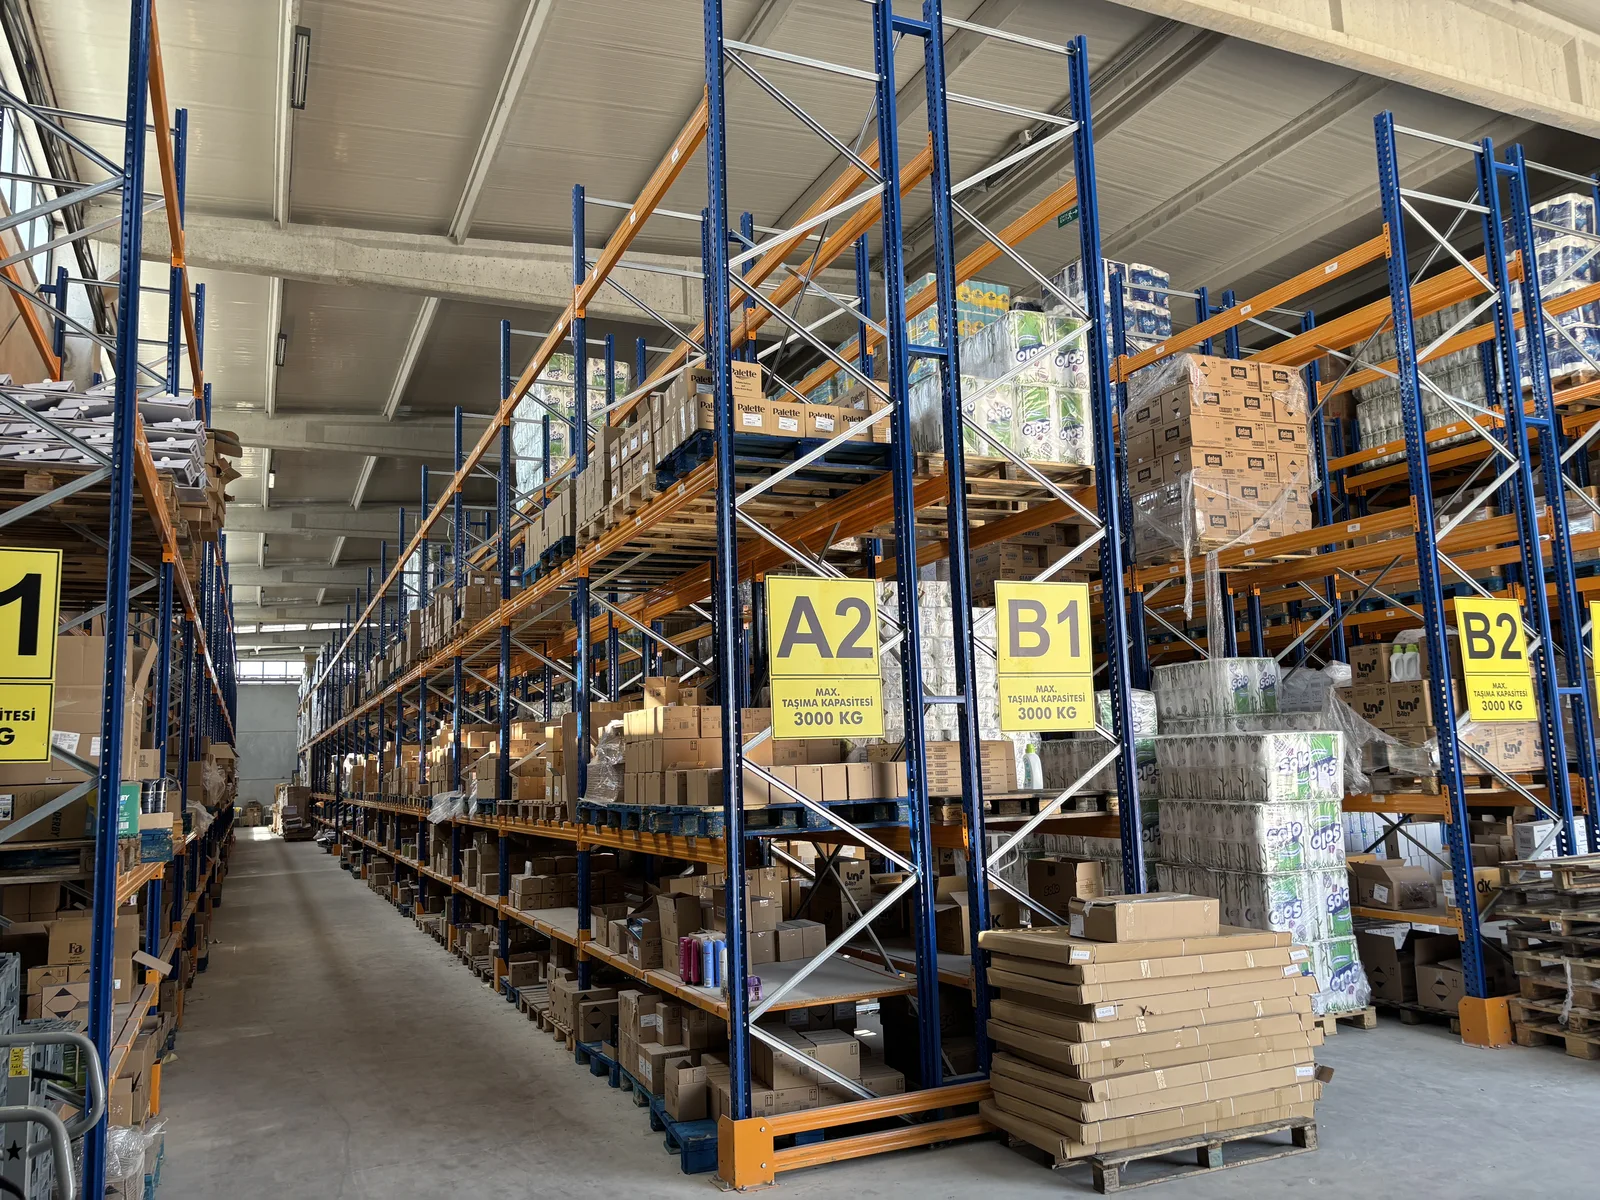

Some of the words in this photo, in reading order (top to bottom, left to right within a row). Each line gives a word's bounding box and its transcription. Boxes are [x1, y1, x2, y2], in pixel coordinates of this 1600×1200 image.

[691, 374, 712, 384] Palett
[738, 403, 766, 414] Palette
[773, 408, 800, 418] Palette
[842, 414, 866, 423] Palett
[776, 596, 874, 658] A2
[1008, 599, 1080, 658] B1
[1463, 612, 1522, 660] B2
[1260, 674, 1276, 690] Solo
[816, 688, 840, 696] MAX.
[1036, 685, 1058, 693] MAX.
[1474, 690, 1495, 699] TAŞIMA
[1496, 688, 1528, 698] KAPASİTESİ
[782, 699, 819, 709] TAŞIMA
[821, 696, 873, 707] KAPASİTESİ
[1008, 695, 1039, 705] TAŞIMA
[1041, 692, 1086, 703] KAPASİTESİ
[1482, 700, 1506, 711] 3000
[1508, 700, 1523, 711] KG
[794, 712, 834, 726] 3000
[840, 711, 864, 724] KG
[1018, 706, 1052, 720] 3000
[1056, 706, 1077, 719] KG
[1311, 824, 1342, 850] Solo
[1044, 884, 1060, 896] Solo
[1326, 887, 1350, 912] Solo
[1269, 900, 1302, 926] Solo
[68, 942, 84, 955] Fa
